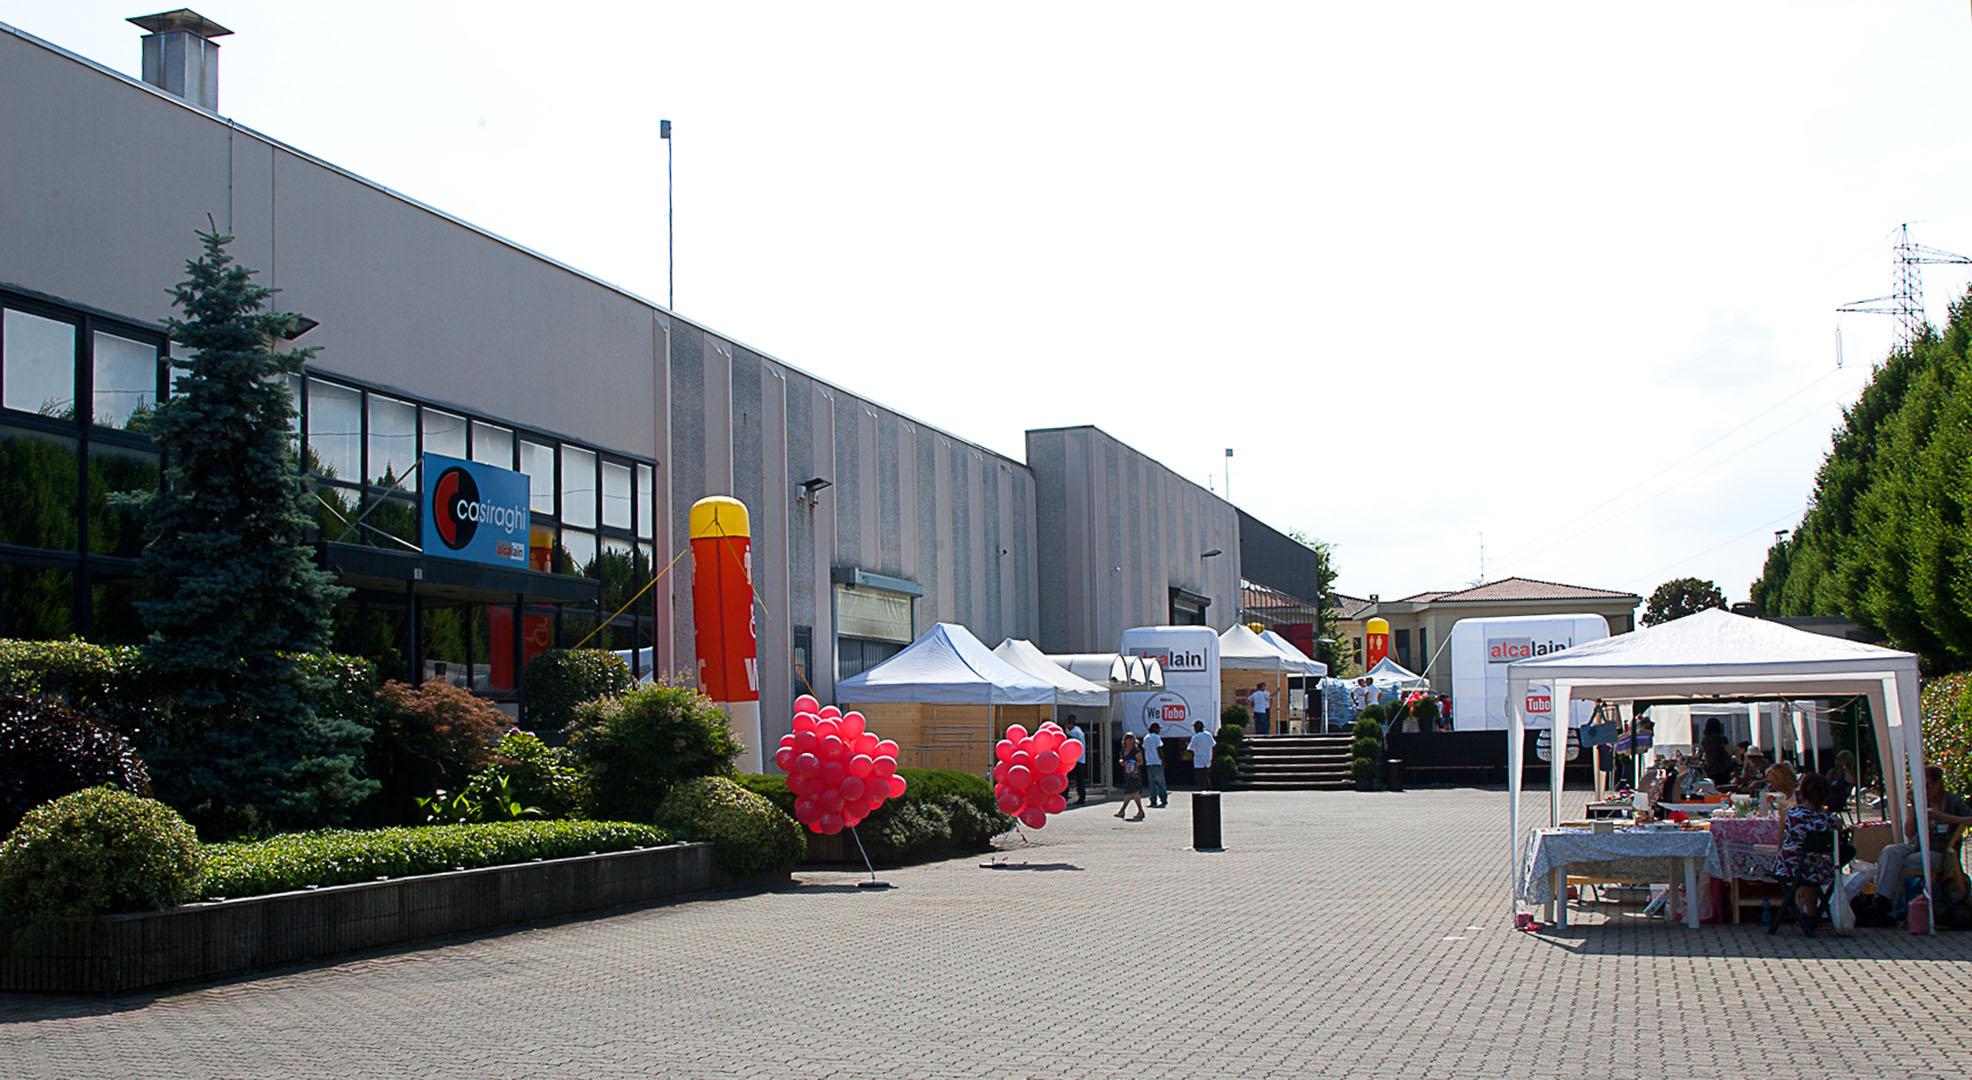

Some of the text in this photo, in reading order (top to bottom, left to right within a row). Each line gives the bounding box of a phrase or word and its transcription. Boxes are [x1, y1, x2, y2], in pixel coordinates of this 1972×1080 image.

[457, 499, 526, 534] casiraghi
[1490, 640, 1566, 658] alcalain
[1137, 650, 1202, 667] alain
[1527, 697, 1551, 711] Tubo
[1147, 706, 1185, 720] We Tubo
